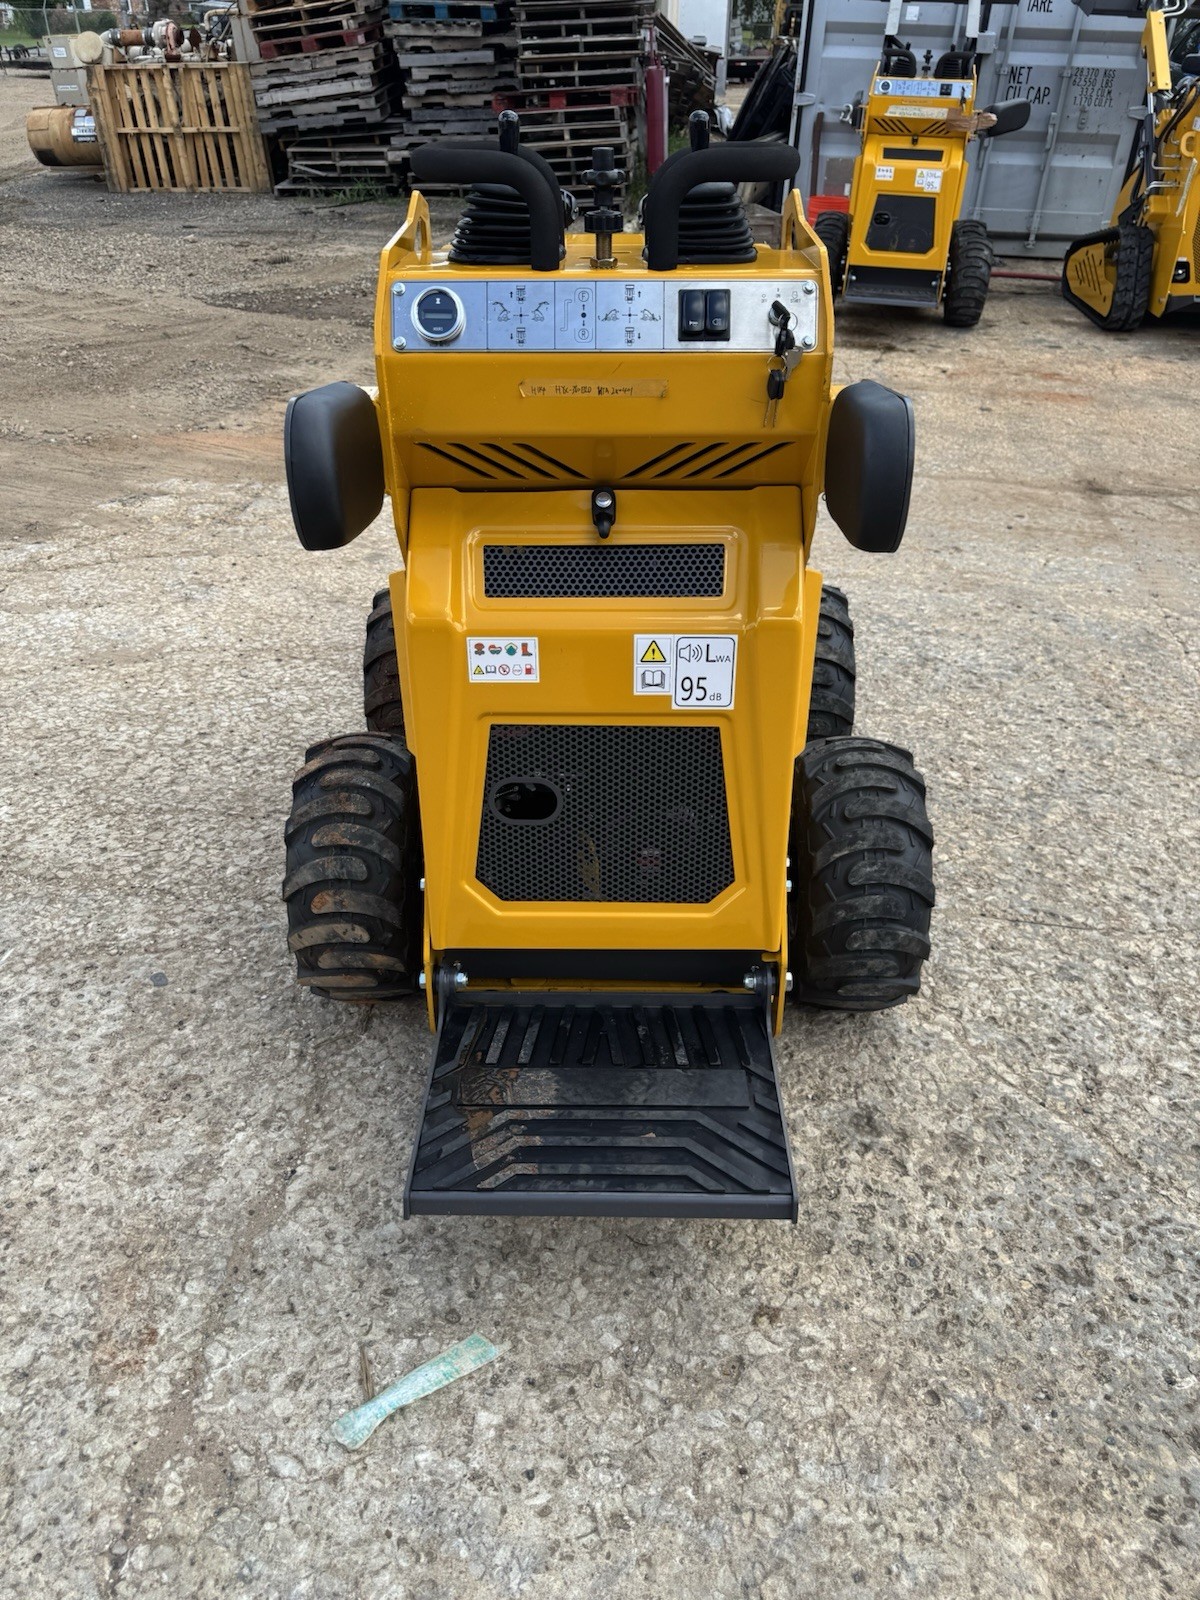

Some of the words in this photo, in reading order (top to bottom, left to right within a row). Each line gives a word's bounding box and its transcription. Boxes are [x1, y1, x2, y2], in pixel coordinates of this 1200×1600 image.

[1008, 66, 1033, 84] NET
[1103, 69, 1116, 79] KGS
[1101, 78, 1113, 88] LBS
[681, 676, 707, 702] 95
[709, 692, 722, 701] dB
